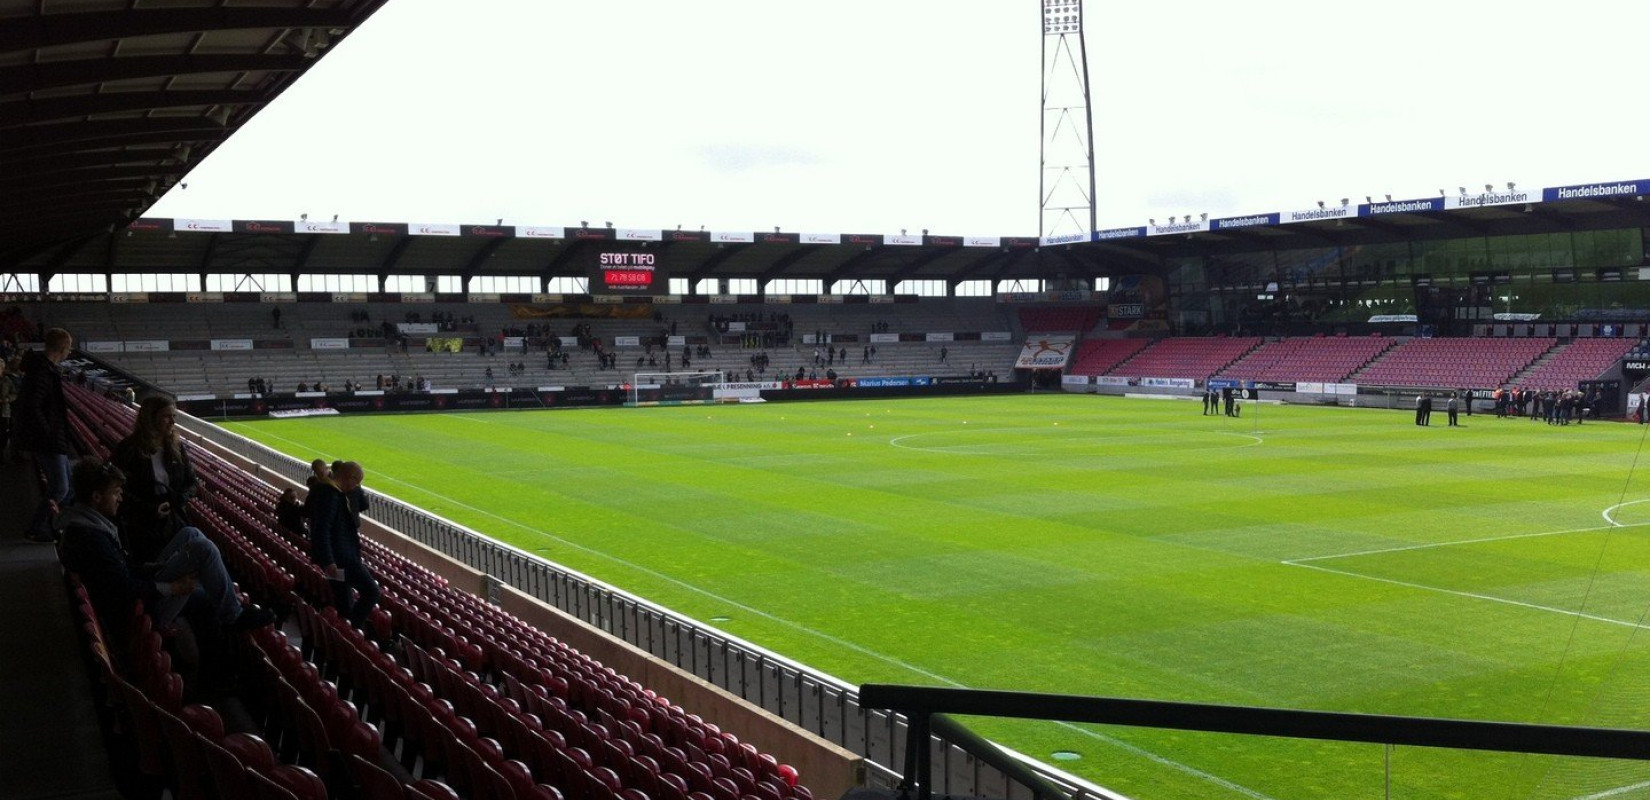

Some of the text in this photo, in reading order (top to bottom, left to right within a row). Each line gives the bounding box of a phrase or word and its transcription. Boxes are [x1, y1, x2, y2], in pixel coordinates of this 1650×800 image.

[1558, 184, 1637, 199] Handelsbanken
[1459, 192, 1527, 206] Handelsbanken
[1370, 200, 1432, 214] Handelsbanken
[1291, 208, 1347, 221] Handelsbanken
[1218, 215, 1269, 228] Handelsbanken
[1098, 228, 1139, 239] Handelsbanken
[1155, 223, 1201, 234] Handelsbanken
[1046, 233, 1084, 244] Handelsbanken
[600, 253, 654, 264] STØT TIFO
[428, 281, 436, 292] 7
[1118, 305, 1142, 316] STARK
[1626, 362, 1646, 370] MCH
